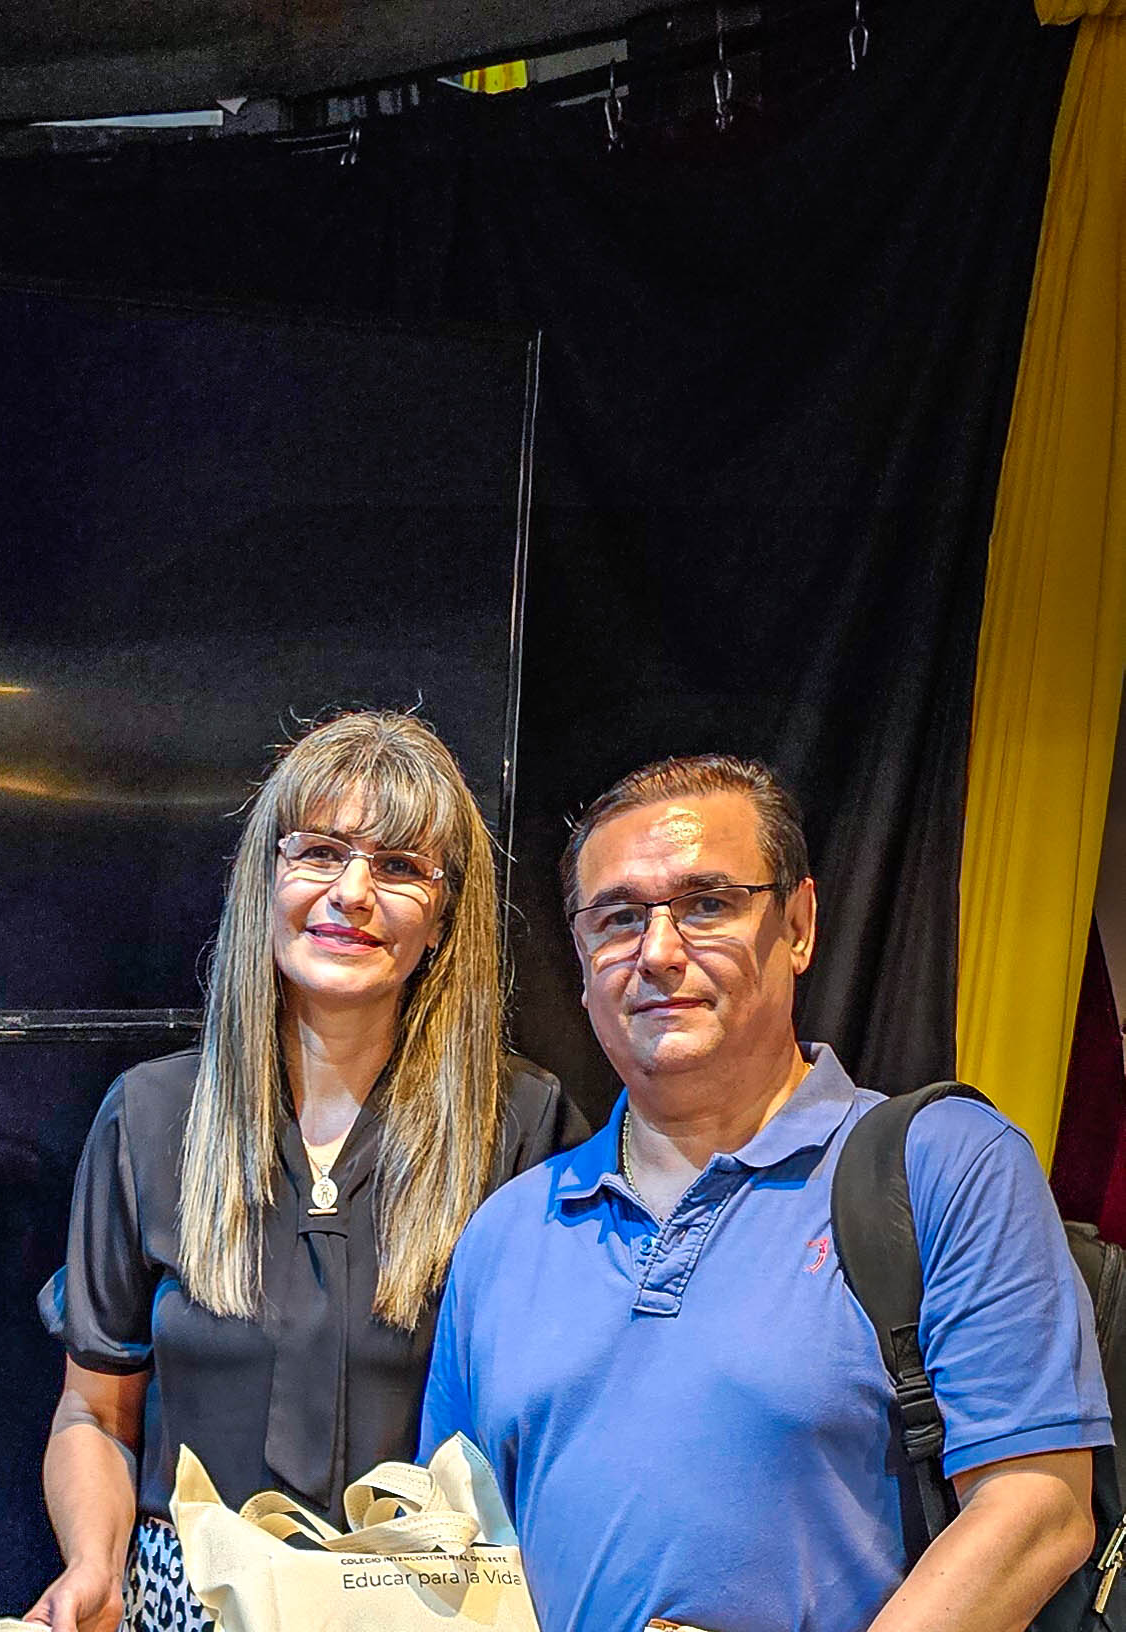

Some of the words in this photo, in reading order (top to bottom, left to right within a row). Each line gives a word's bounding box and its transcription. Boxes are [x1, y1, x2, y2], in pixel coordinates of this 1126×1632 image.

[343, 1572, 412, 1589] Educar
[418, 1571, 460, 1588] para
[464, 1569, 480, 1585] la
[483, 1568, 522, 1586] Vida
